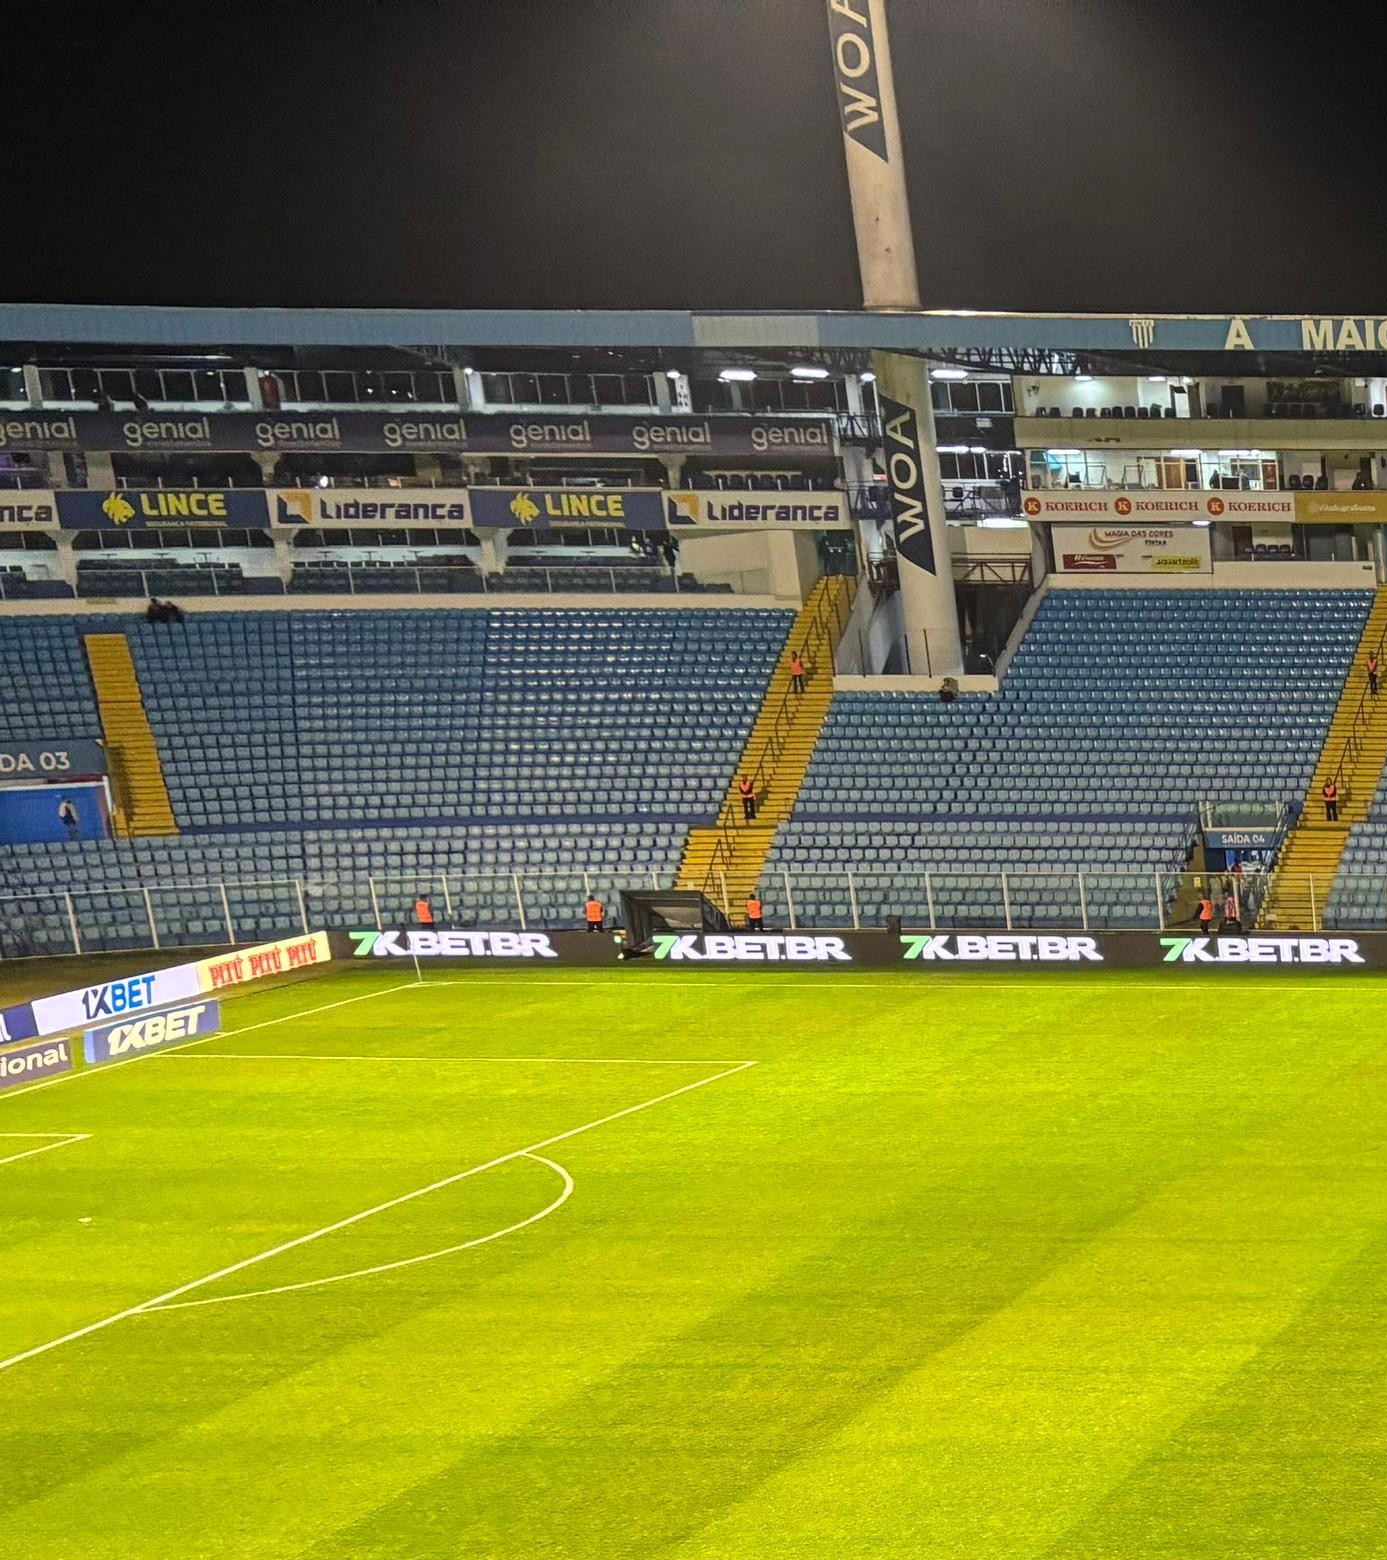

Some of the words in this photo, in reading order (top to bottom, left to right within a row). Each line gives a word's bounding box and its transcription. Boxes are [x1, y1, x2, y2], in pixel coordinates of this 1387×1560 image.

[1224, 319, 1254, 350] A
[124, 417, 210, 447] genial
[256, 417, 340, 447] genial
[384, 418, 467, 447] genial
[510, 420, 590, 448] genial
[633, 421, 711, 449] genial
[751, 423, 828, 450] genial
[886, 410, 928, 545] WOA
[141, 492, 226, 518] LINCE
[545, 493, 625, 518] LINCE
[1046, 501, 1108, 511] KOERICH
[1136, 501, 1200, 511] KOERICH
[1228, 502, 1291, 512] KOERICH
[40, 751, 70, 771] 03
[1222, 833, 1250, 844] SAÍDA
[1252, 834, 1265, 843] 04
[82, 975, 155, 1020] 1XBET
[107, 1005, 205, 1056] 1XBET
